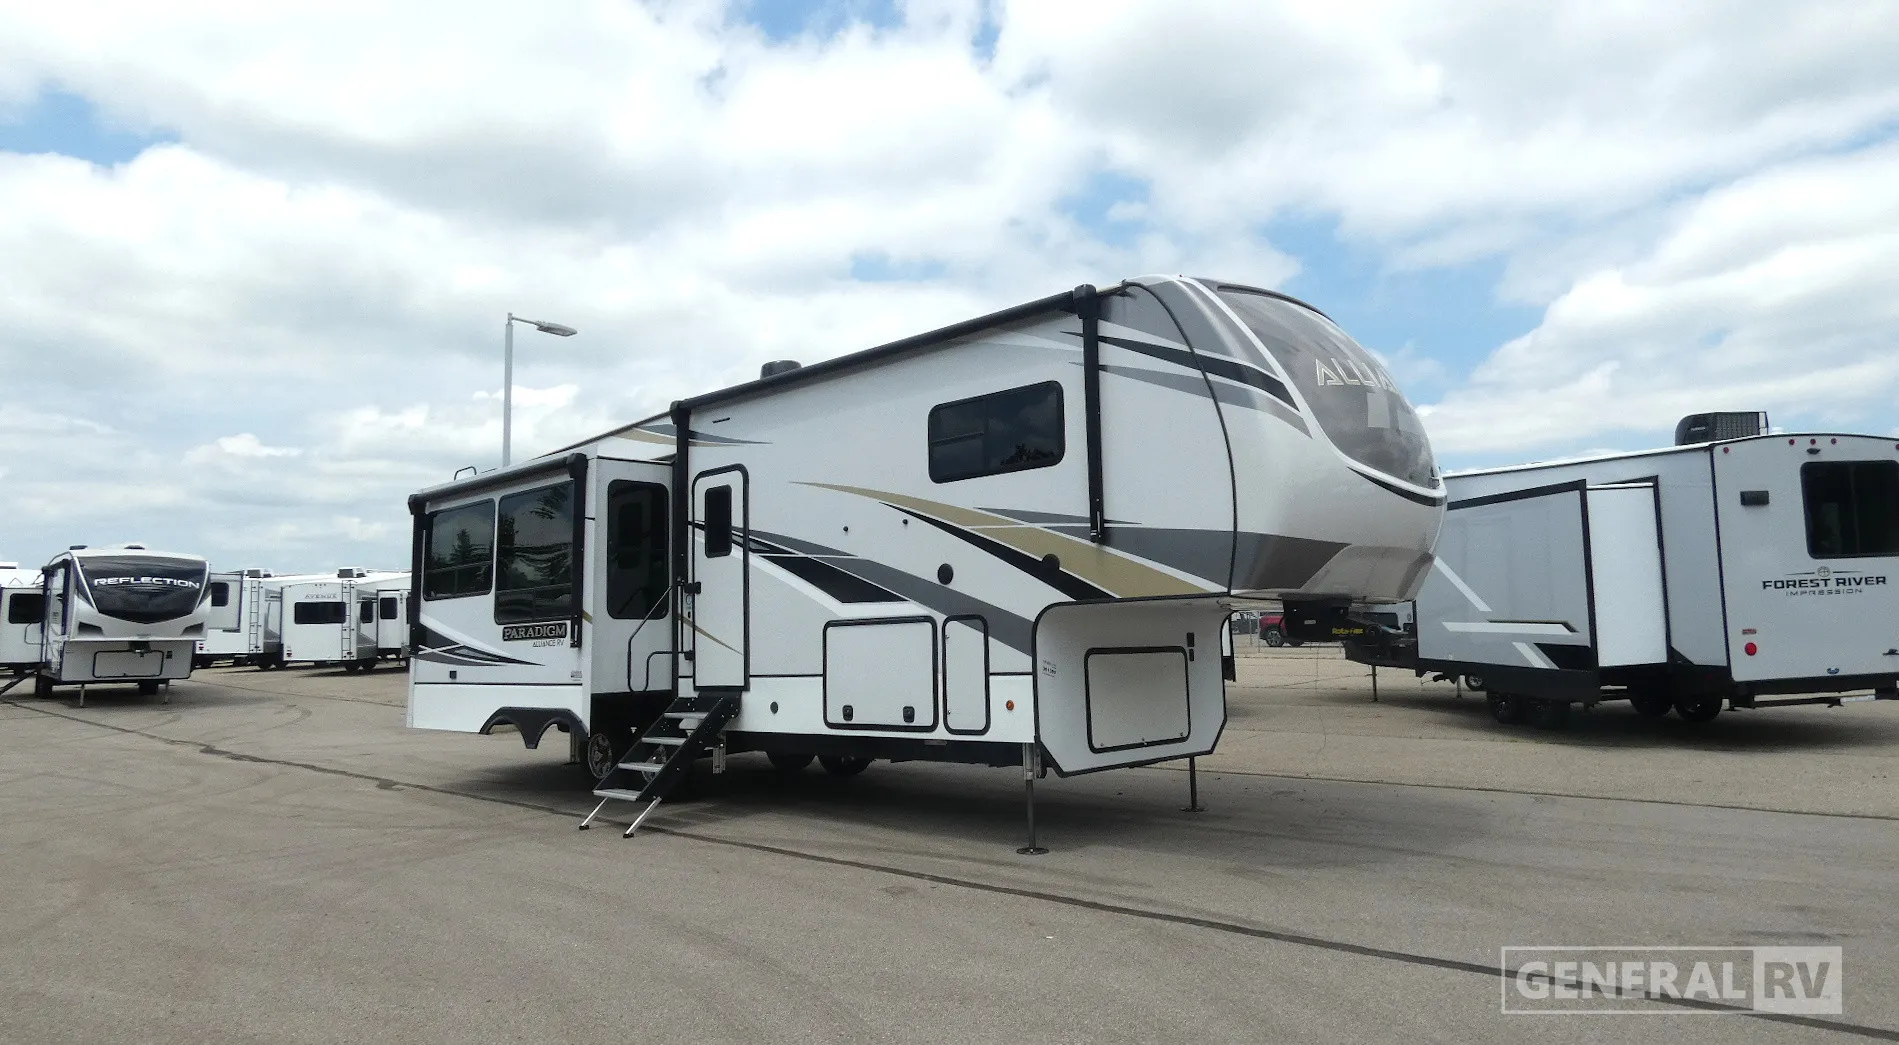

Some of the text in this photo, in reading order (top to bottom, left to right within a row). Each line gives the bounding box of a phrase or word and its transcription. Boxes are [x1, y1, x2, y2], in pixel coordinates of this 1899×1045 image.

[94, 576, 200, 589] REFLECTION
[1762, 576, 1887, 590] FOREST RIVER
[1785, 588, 1863, 596] IMPRESSION
[503, 624, 566, 640] PARADIGM
[532, 640, 556, 648] ALLIANCE
